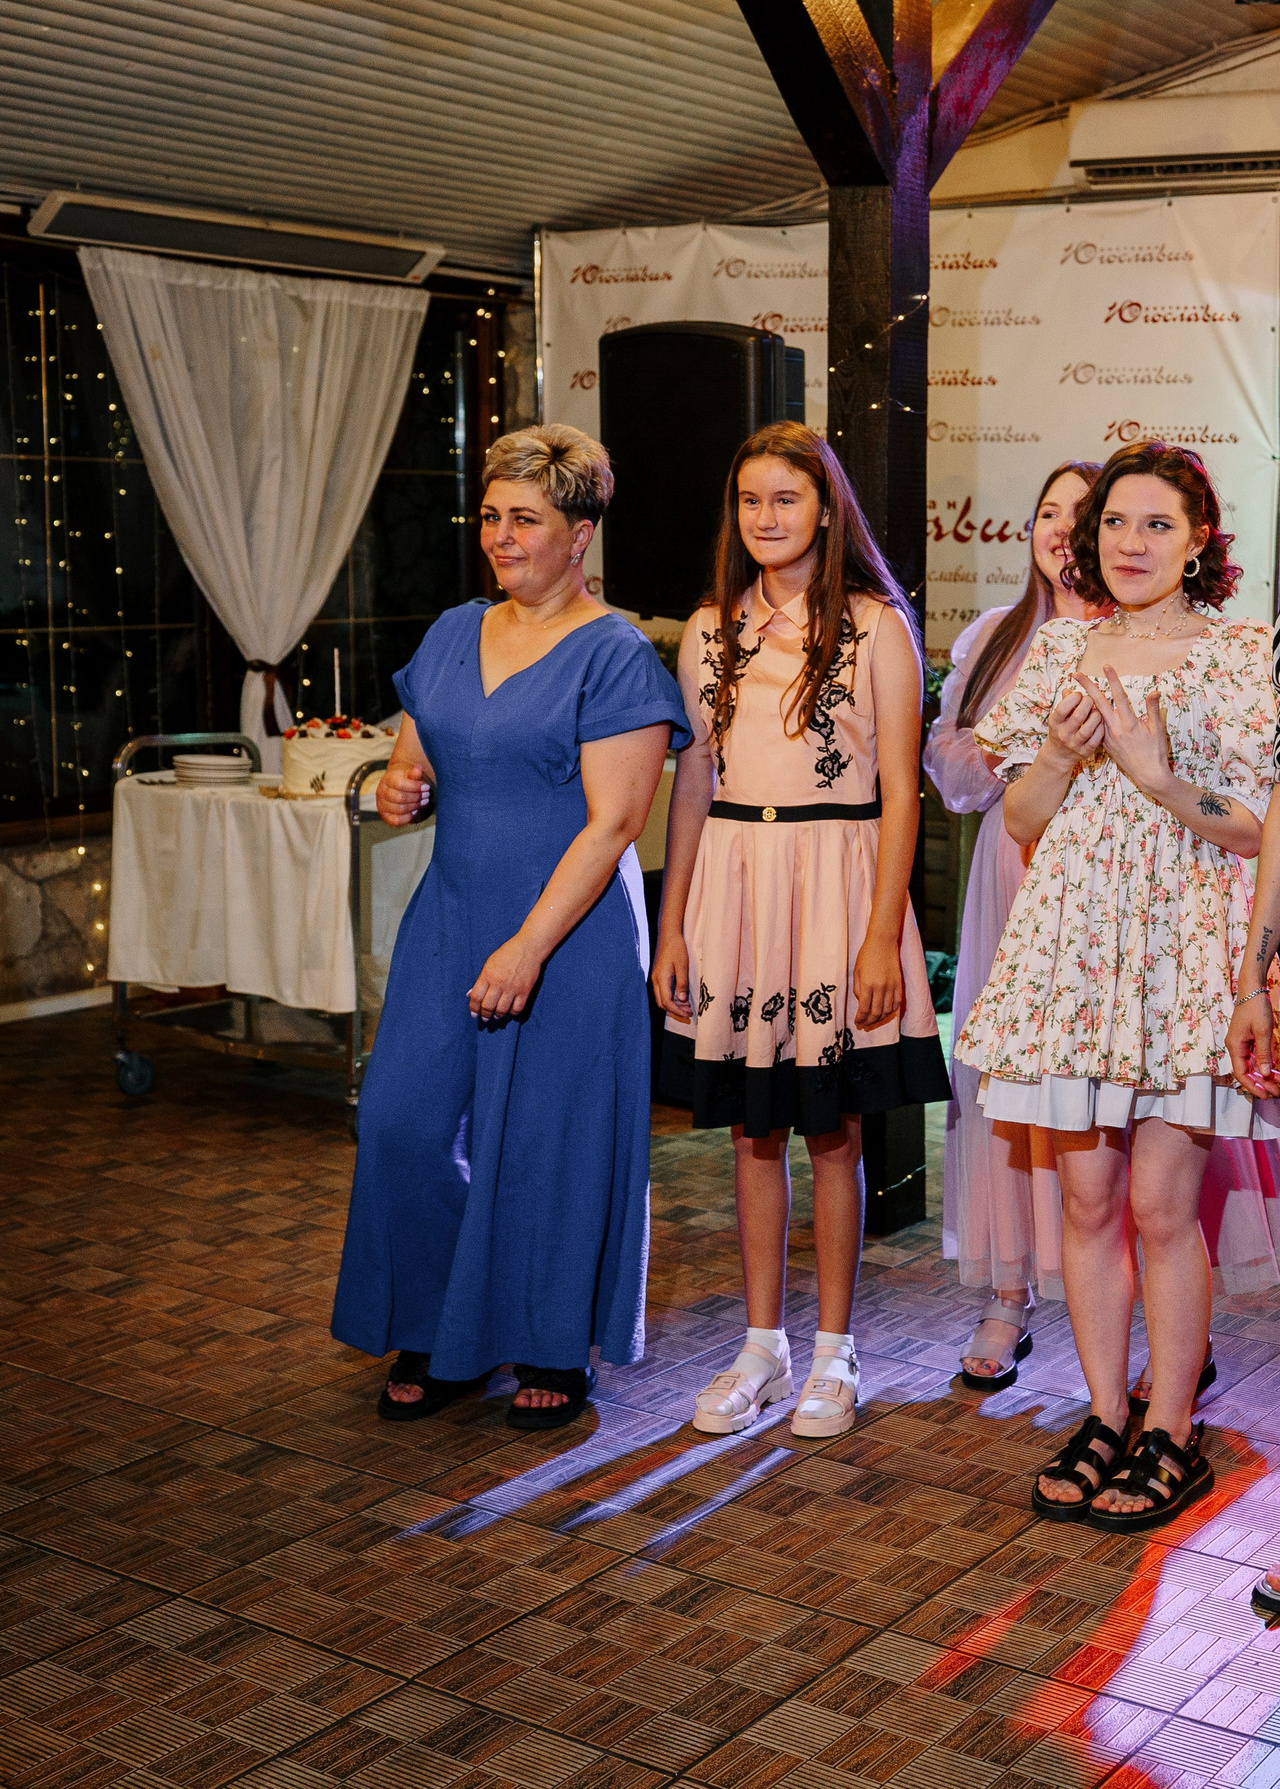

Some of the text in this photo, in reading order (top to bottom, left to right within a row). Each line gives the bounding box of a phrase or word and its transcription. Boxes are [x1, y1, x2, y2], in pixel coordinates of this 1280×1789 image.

[1059, 240, 1194, 265] Югославия
[1103, 299, 1241, 324] Югославия
[1059, 361, 1193, 385] Югославия
[1256, 926, 1273, 962] Young
